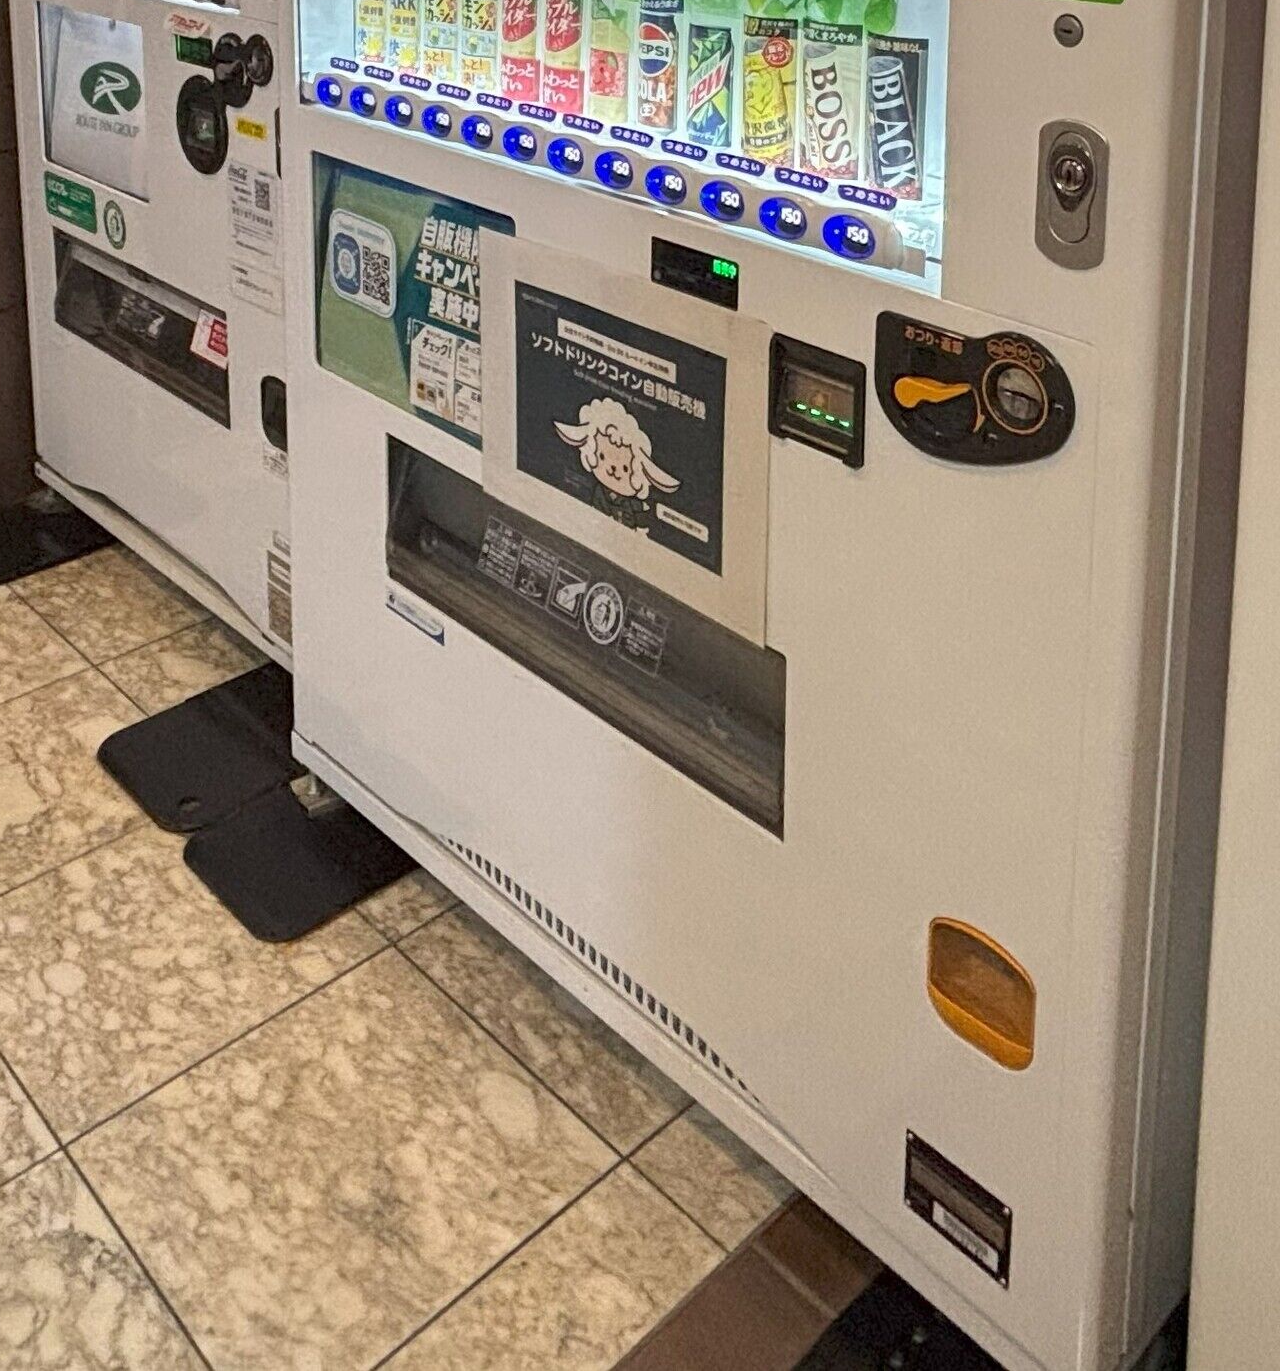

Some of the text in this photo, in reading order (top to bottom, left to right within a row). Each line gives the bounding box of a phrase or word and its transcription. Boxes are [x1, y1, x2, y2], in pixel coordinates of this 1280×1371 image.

[811, 62, 852, 164] BOSS
[871, 69, 917, 188] BLACK
[665, 142, 706, 161] つめたい
[719, 155, 764, 176] つめたい
[664, 175, 683, 191] 150
[778, 170, 827, 193] つめたい
[720, 191, 740, 208] 150
[842, 187, 895, 210] つめたい
[781, 207, 802, 225] 150
[846, 227, 869, 244] 150
[416, 249, 480, 296] キャンペ
